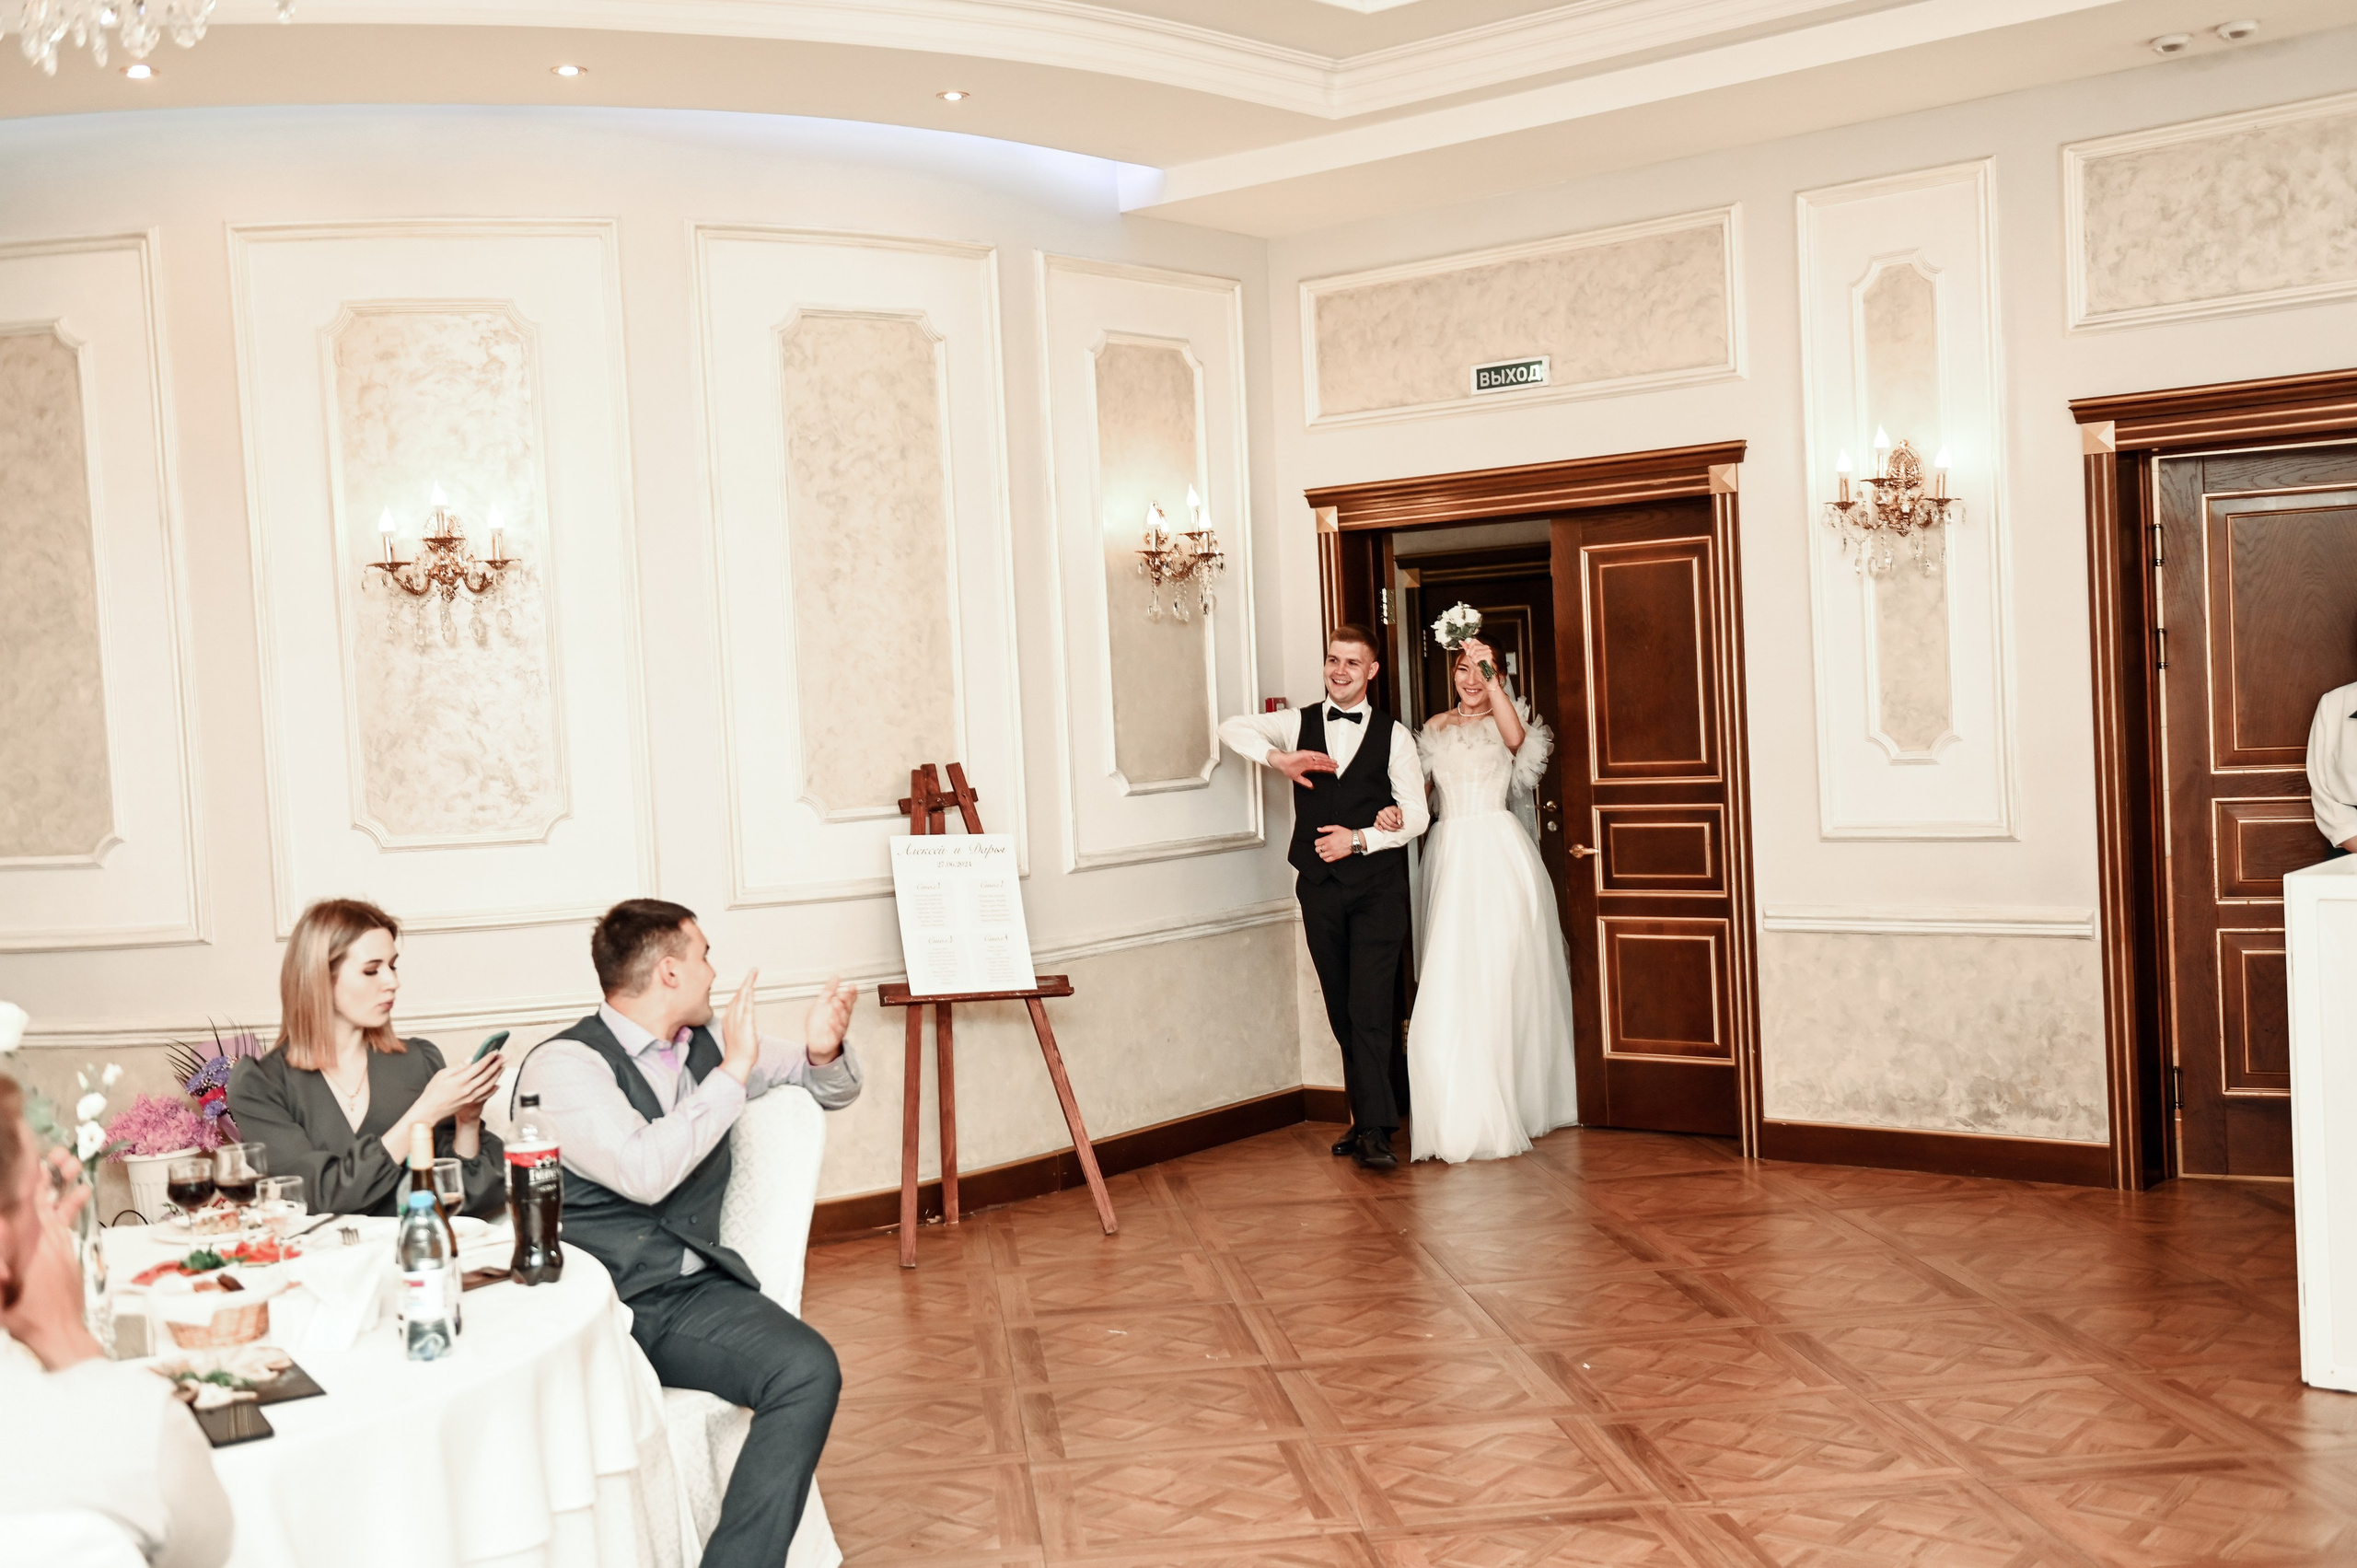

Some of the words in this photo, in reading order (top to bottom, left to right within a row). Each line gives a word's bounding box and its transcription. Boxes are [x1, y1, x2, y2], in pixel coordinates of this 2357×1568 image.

[1480, 365, 1542, 387] ВЫХОД
[897, 842, 946, 855] Алексей
[969, 842, 1005, 858] Дарья
